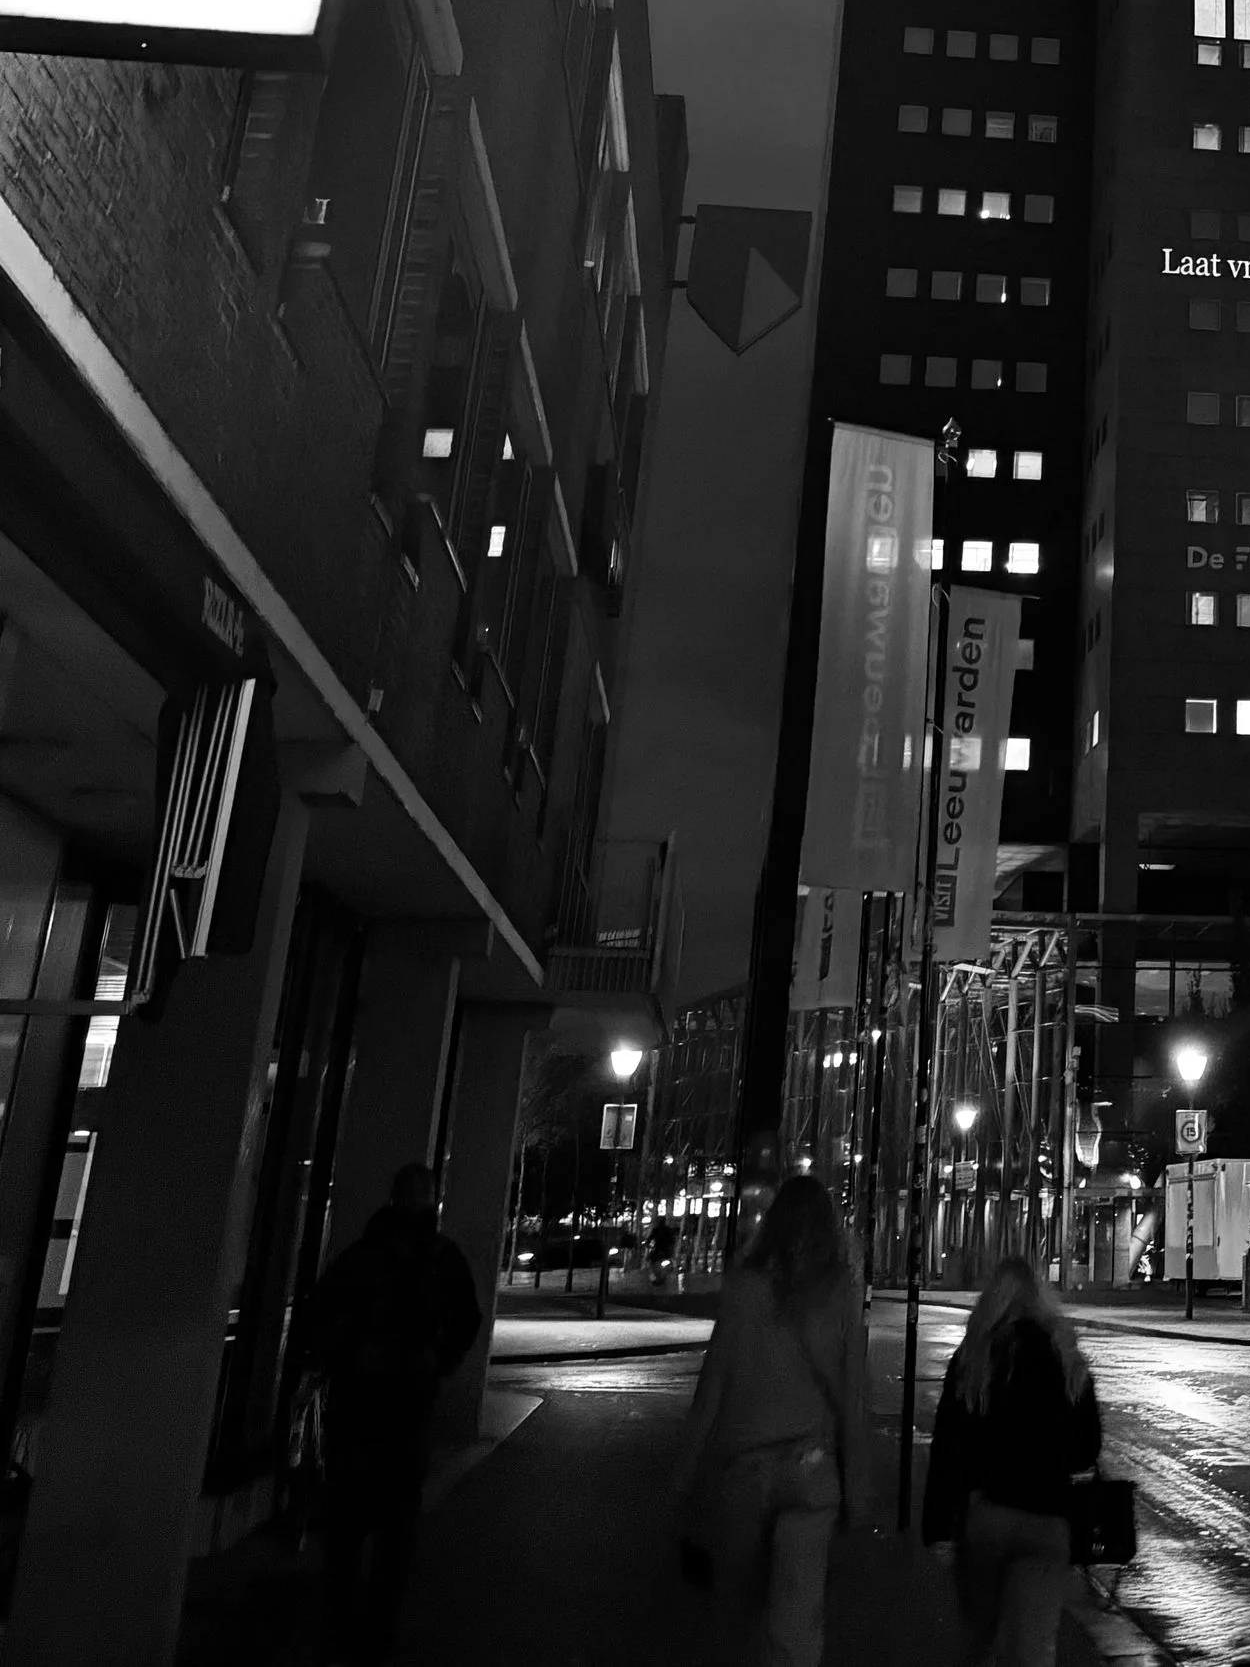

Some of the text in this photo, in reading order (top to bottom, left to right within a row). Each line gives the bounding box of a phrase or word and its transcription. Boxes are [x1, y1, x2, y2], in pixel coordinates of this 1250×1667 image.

[1161, 248, 1222, 278] Laat
[1186, 546, 1225, 569] De
[935, 616, 985, 871] Leeuwarden
